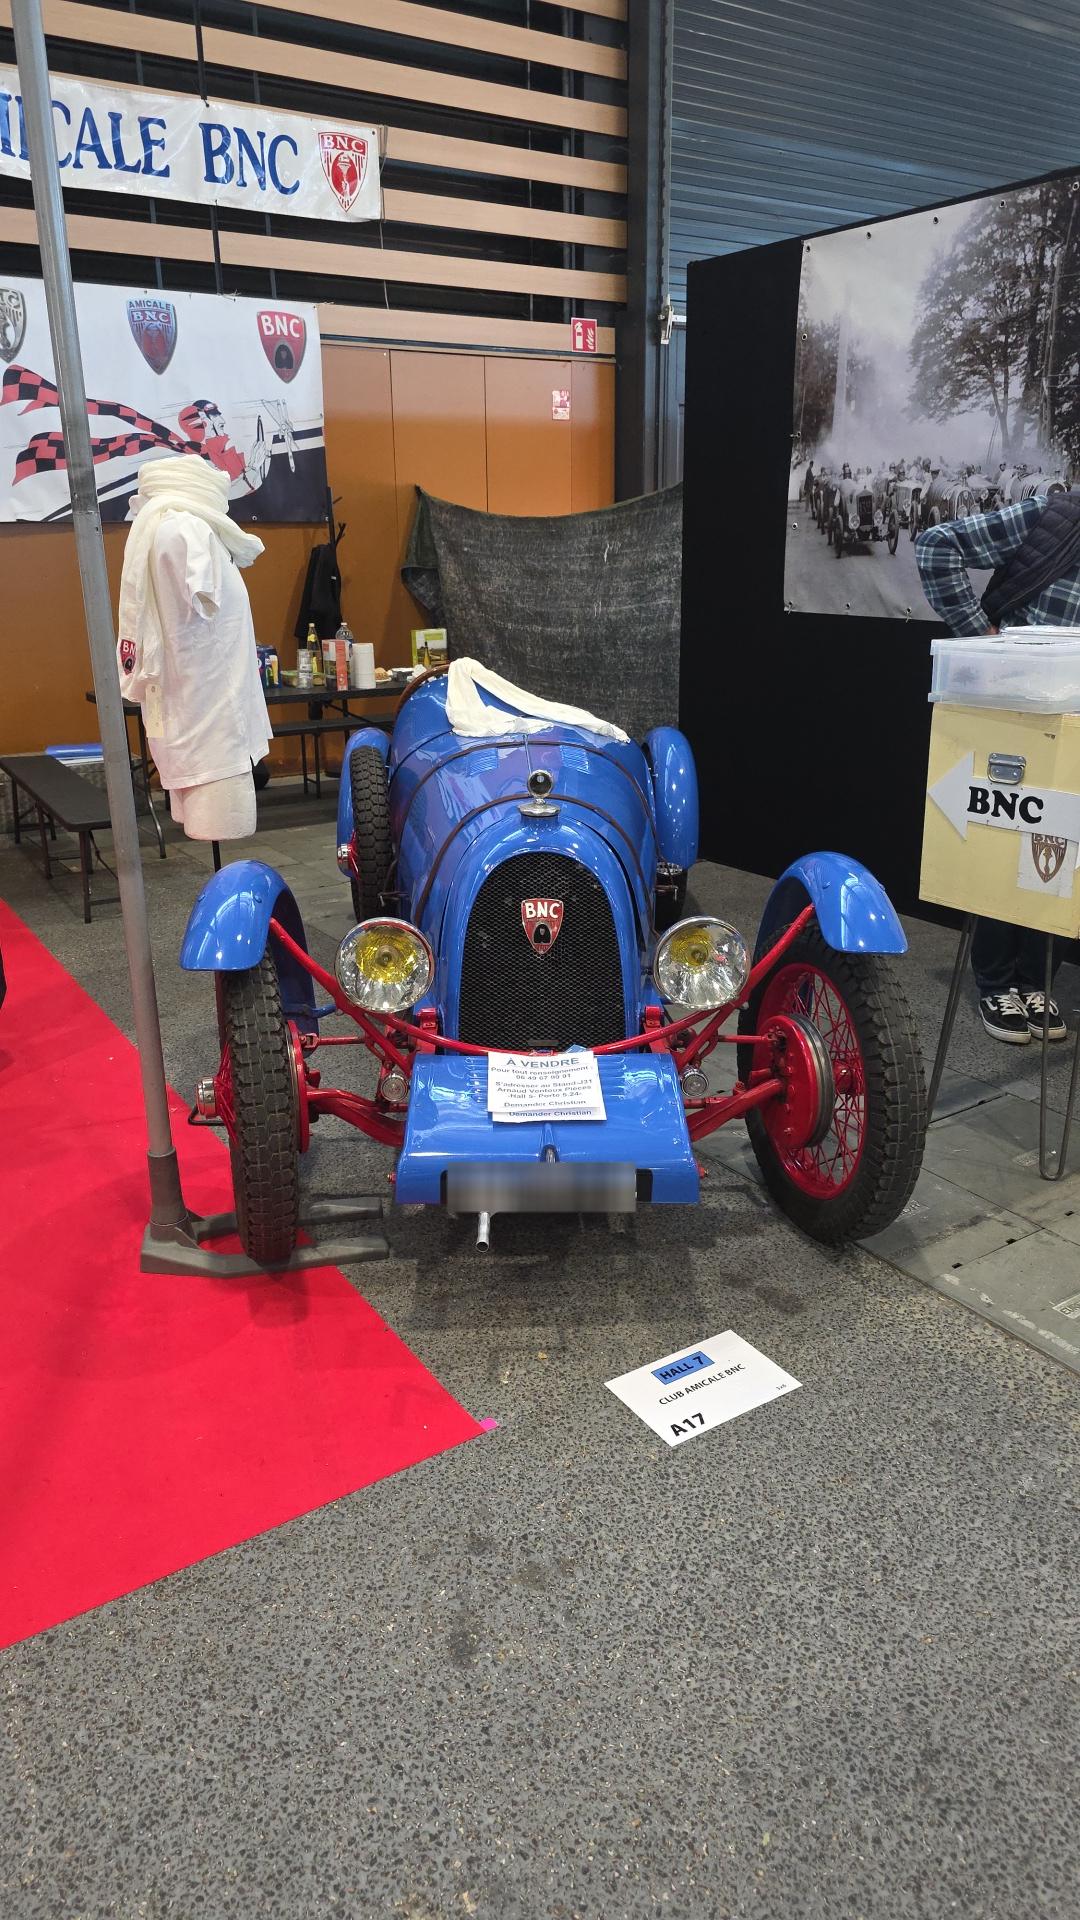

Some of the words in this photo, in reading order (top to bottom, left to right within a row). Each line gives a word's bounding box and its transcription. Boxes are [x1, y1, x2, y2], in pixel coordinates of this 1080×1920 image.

[322, 135, 364, 153] BNC
[199, 122, 301, 196] BNC
[128, 299, 172, 311] AMICALE
[132, 310, 170, 323] BNC
[261, 314, 301, 338] BNC
[967, 785, 1044, 824] BNC
[524, 901, 560, 919] BNC
[520, 1057, 580, 1068] VENDRE
[529, 1066, 589, 1076] renseignement
[553, 1109, 592, 1117] Christian
[659, 1362, 694, 1380] HALL
[692, 1355, 704, 1365] 7
[658, 1390, 685, 1405] CLUB
[684, 1372, 726, 1395] AMICALE
[724, 1363, 746, 1378] BNC
[670, 1412, 706, 1437] A17
